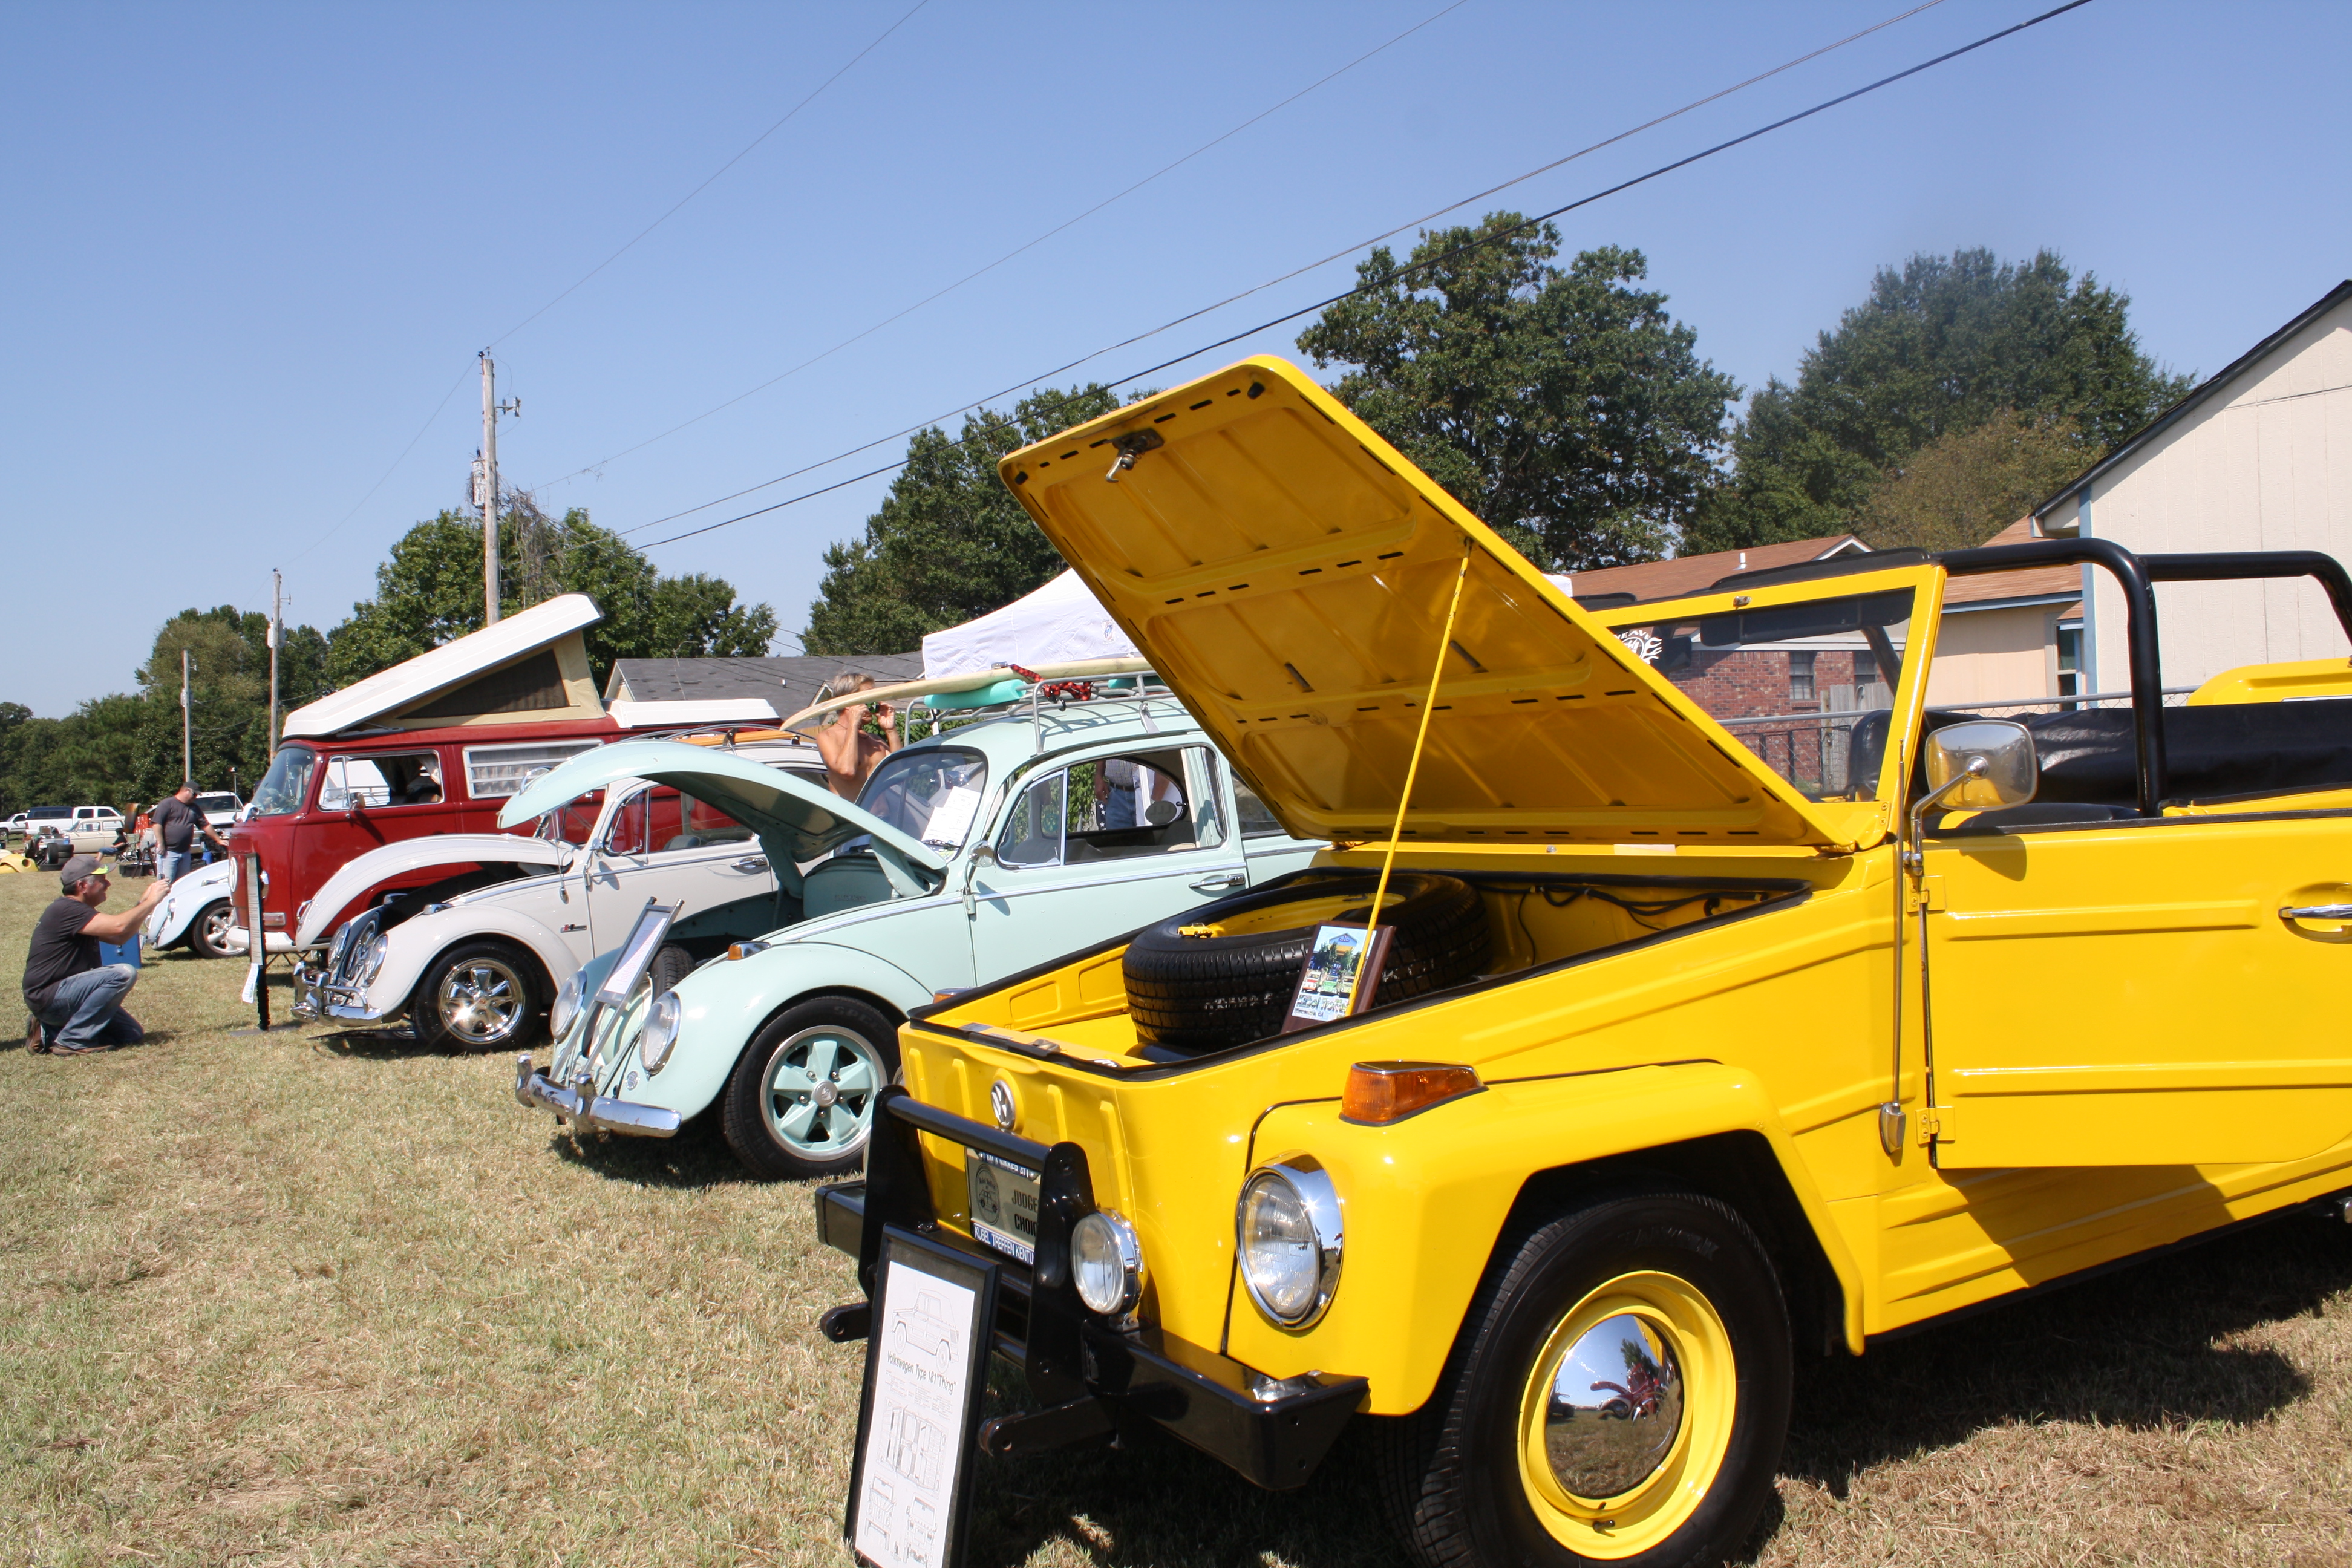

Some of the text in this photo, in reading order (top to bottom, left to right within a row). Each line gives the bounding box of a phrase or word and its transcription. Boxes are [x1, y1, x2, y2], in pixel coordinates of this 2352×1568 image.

[1020, 1167, 1026, 1175] AT
[974, 1226, 991, 1245] KUBEL
[991, 1233, 1014, 1256] TREFFEN
[887, 1350, 957, 1396] Volkswagen Type 181 "Thing"
